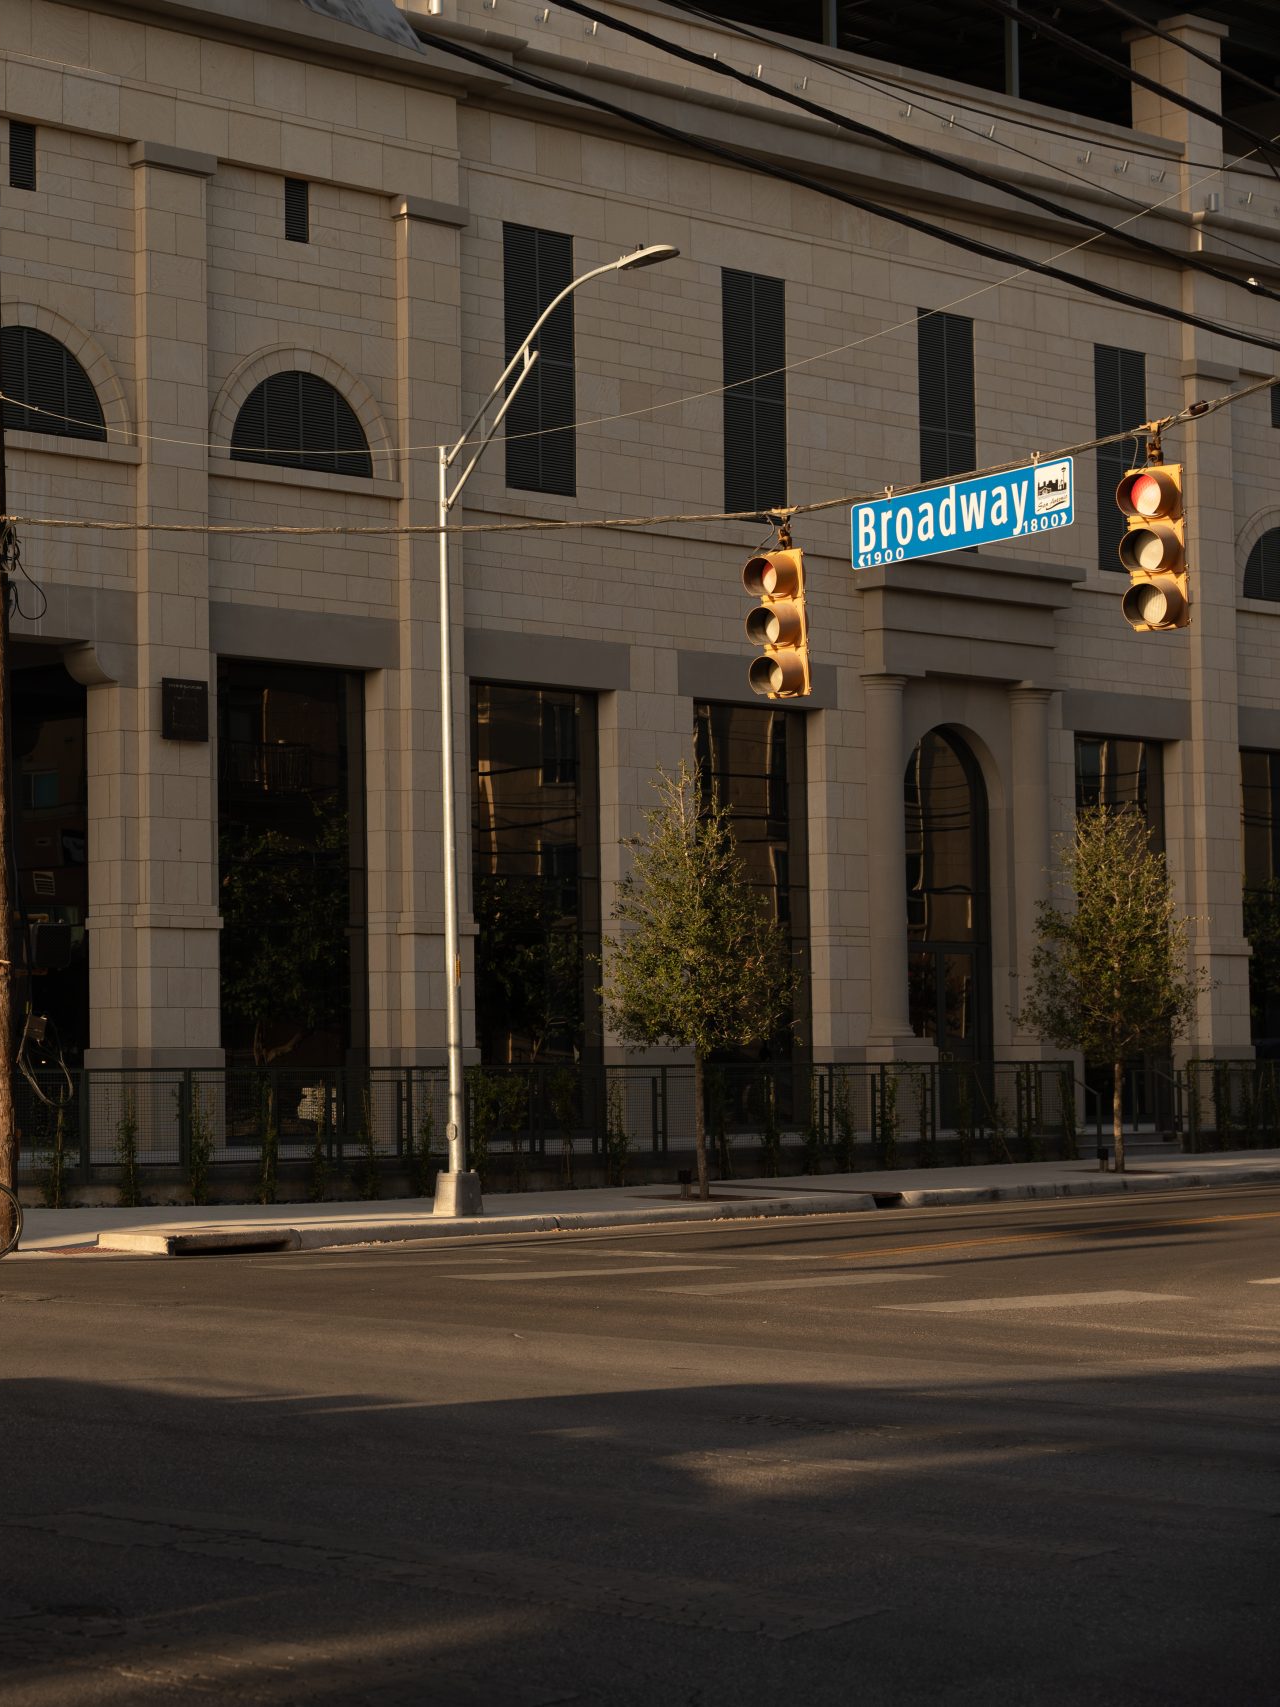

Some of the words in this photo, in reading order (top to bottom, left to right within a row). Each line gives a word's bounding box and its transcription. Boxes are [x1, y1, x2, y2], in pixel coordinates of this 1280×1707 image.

[858, 479, 1029, 554] Broadway
[1023, 513, 1060, 533] 1800
[866, 547, 905, 567] 1900
